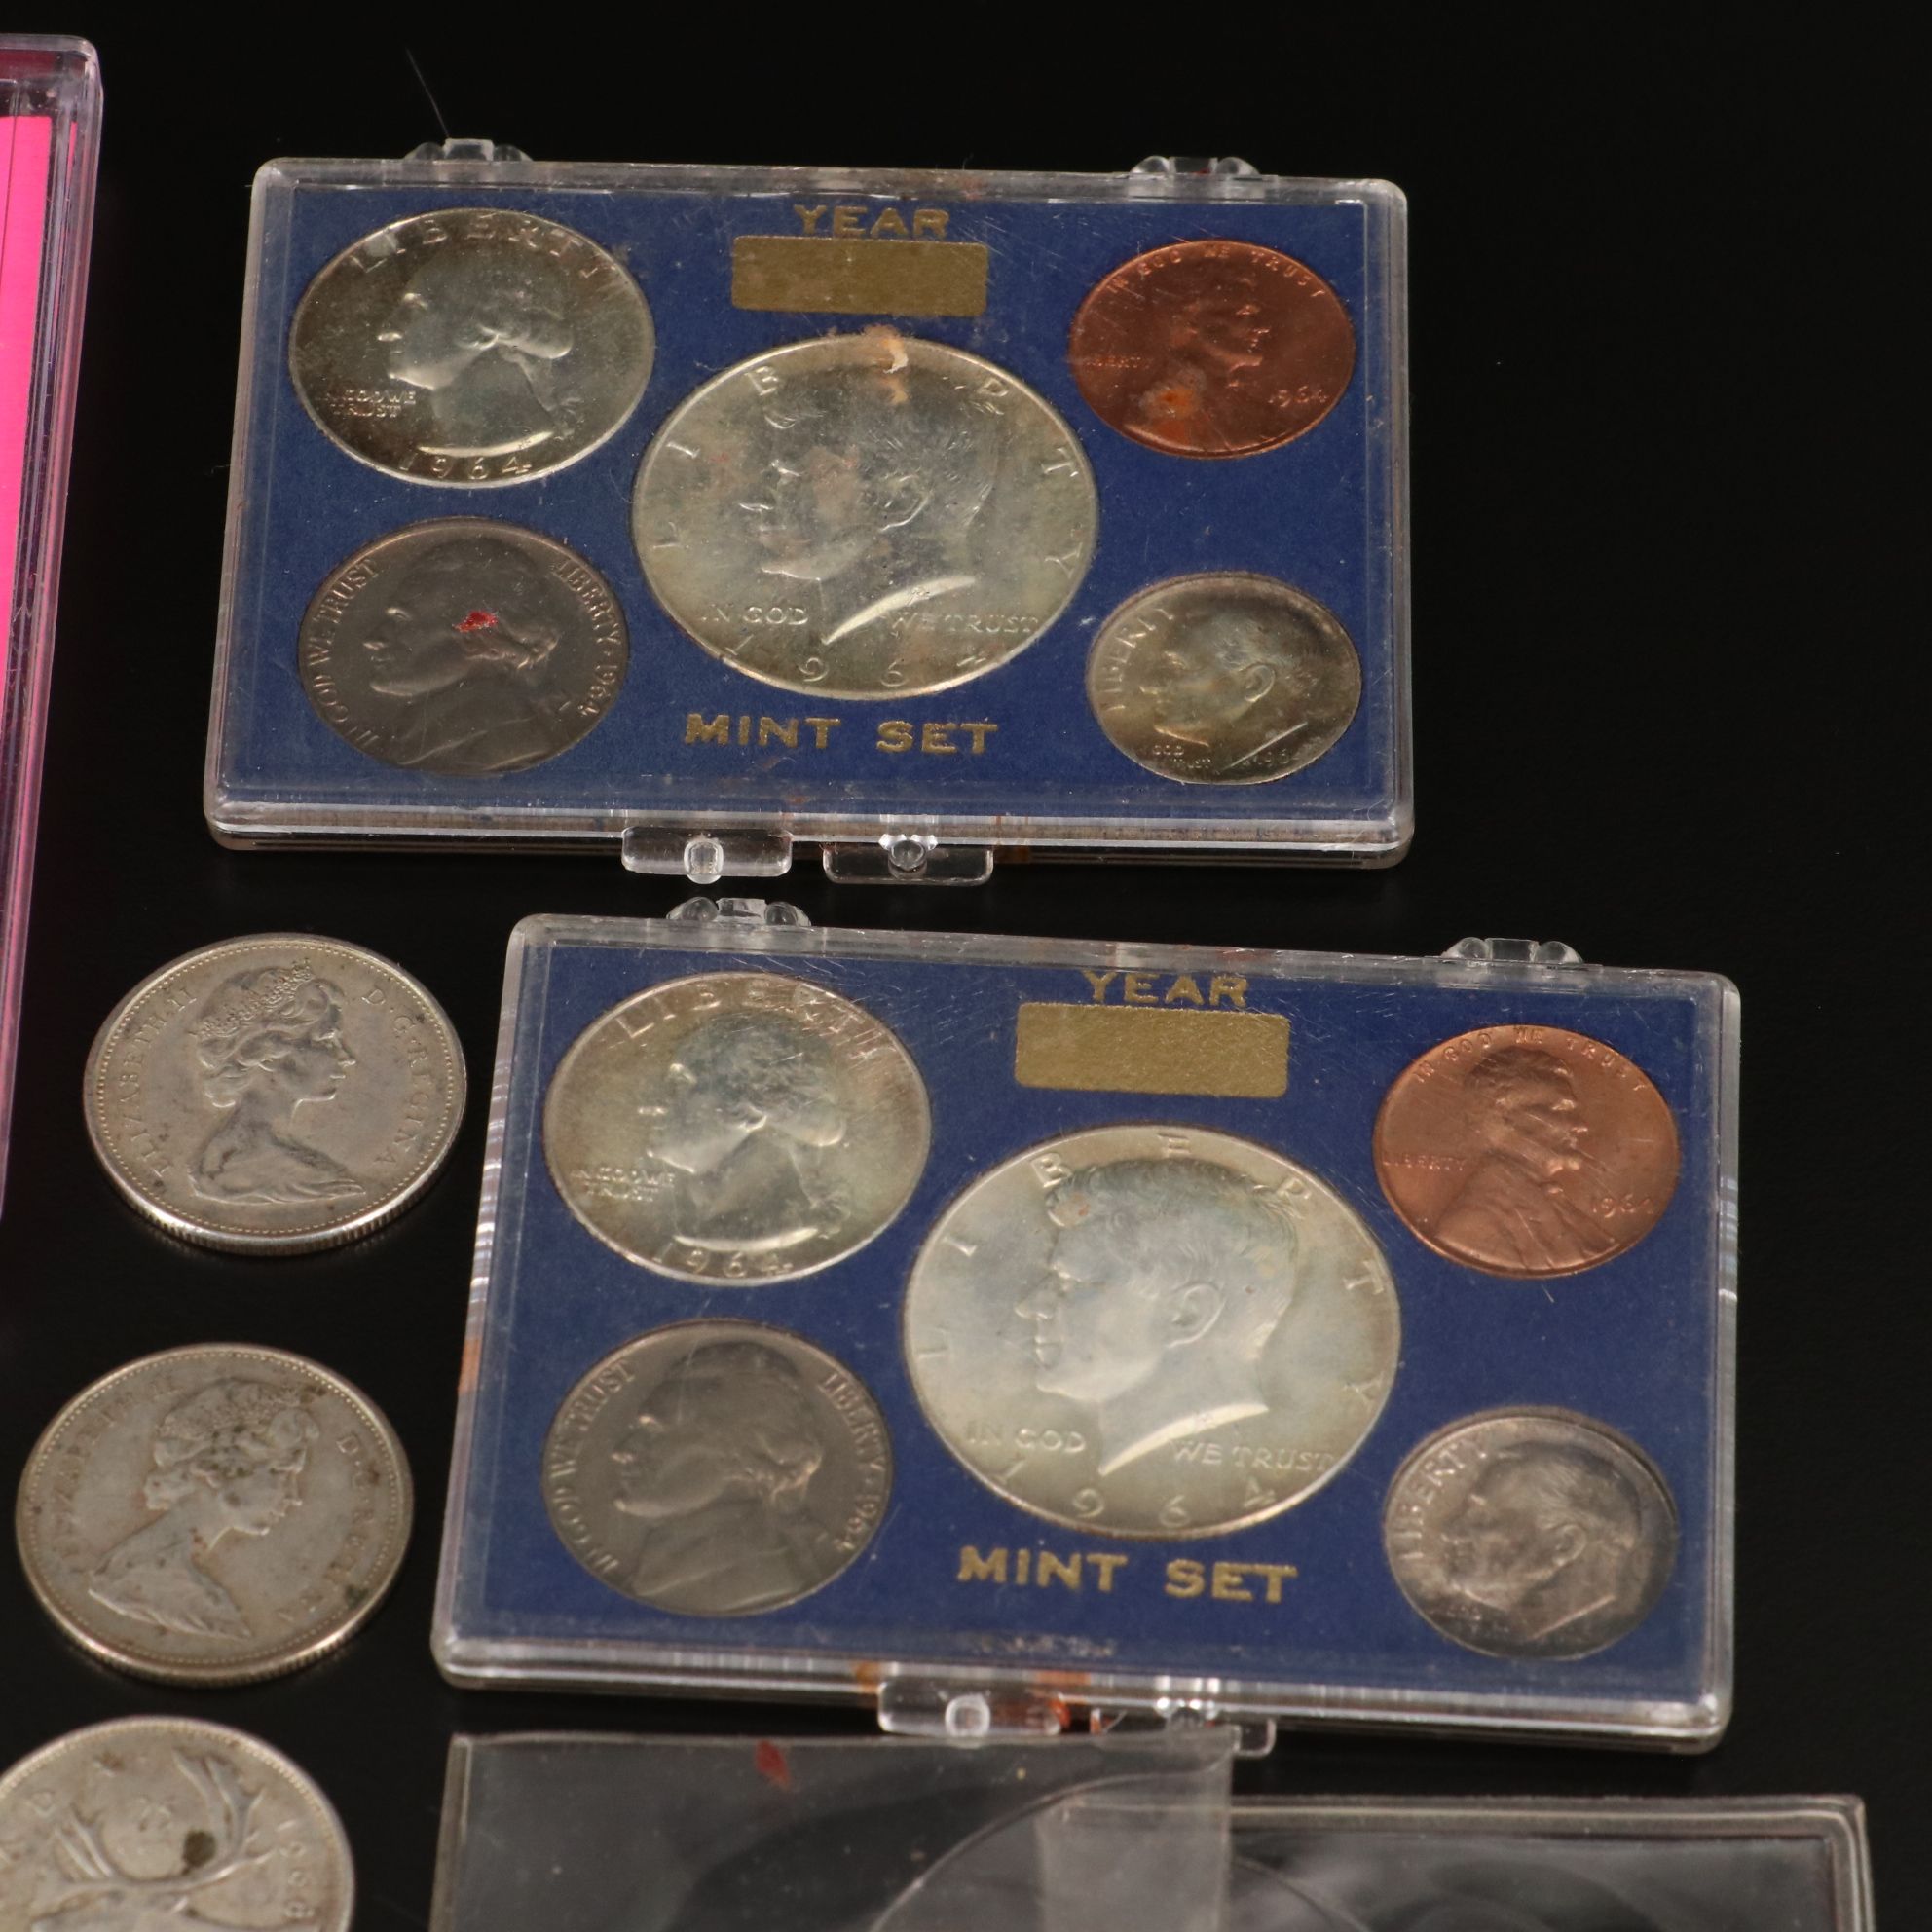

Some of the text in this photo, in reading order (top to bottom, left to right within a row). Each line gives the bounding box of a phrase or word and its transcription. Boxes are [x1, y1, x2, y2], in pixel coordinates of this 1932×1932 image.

[794, 204, 950, 239] YEAR
[399, 454, 533, 480] 1964
[653, 343, 1084, 578] LIBRTY
[742, 605, 809, 626] GOD
[685, 712, 999, 755] MINT SET
[1082, 969, 1250, 1008] YEAR
[918, 1133, 1385, 1400] LIBERTY
[1014, 1428, 1087, 1453] GOD
[1170, 1440, 1224, 1464] WE
[1233, 1447, 1337, 1472] TRUST
[993, 1461, 1277, 1529] 1964
[957, 1545, 1299, 1604] MINT SET
